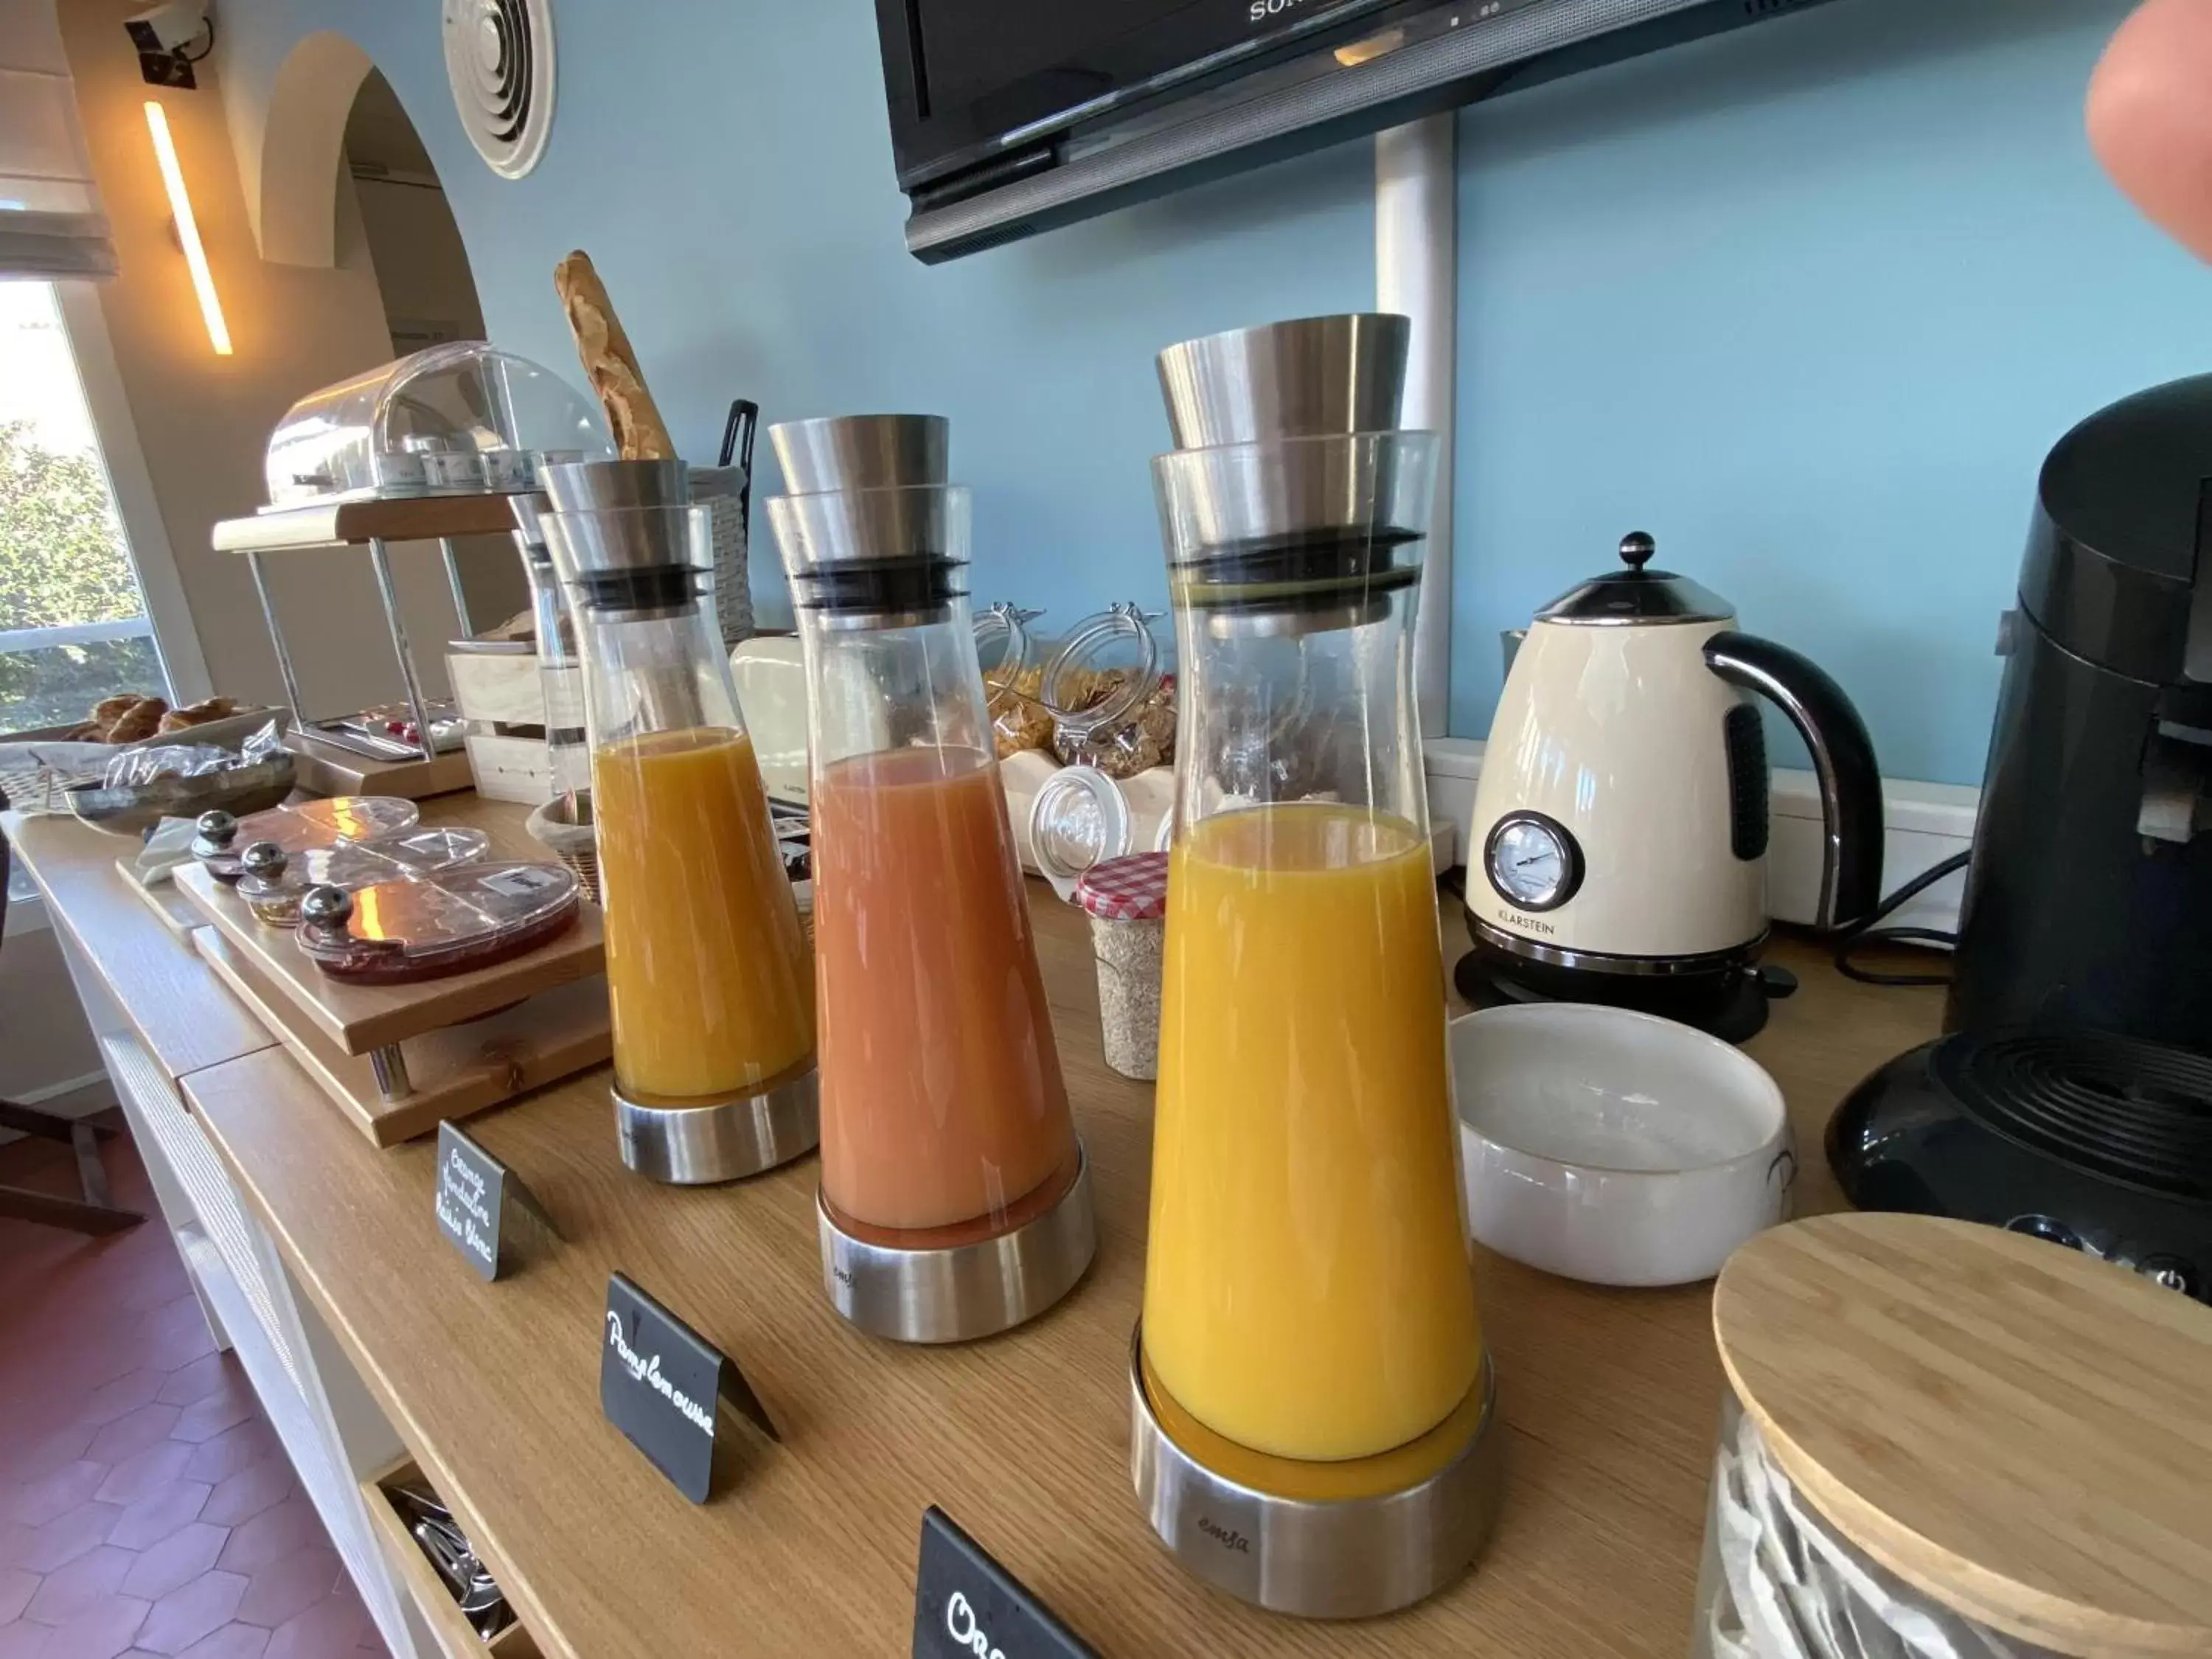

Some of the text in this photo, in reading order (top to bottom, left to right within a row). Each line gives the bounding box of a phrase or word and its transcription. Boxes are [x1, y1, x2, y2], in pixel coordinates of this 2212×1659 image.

[1250, 0, 1303, 21] SO
[1498, 909, 1556, 936] KLARSTEIN
[607, 1310, 714, 1438] Pamplemousse
[1197, 1516, 1250, 1554] emsa
